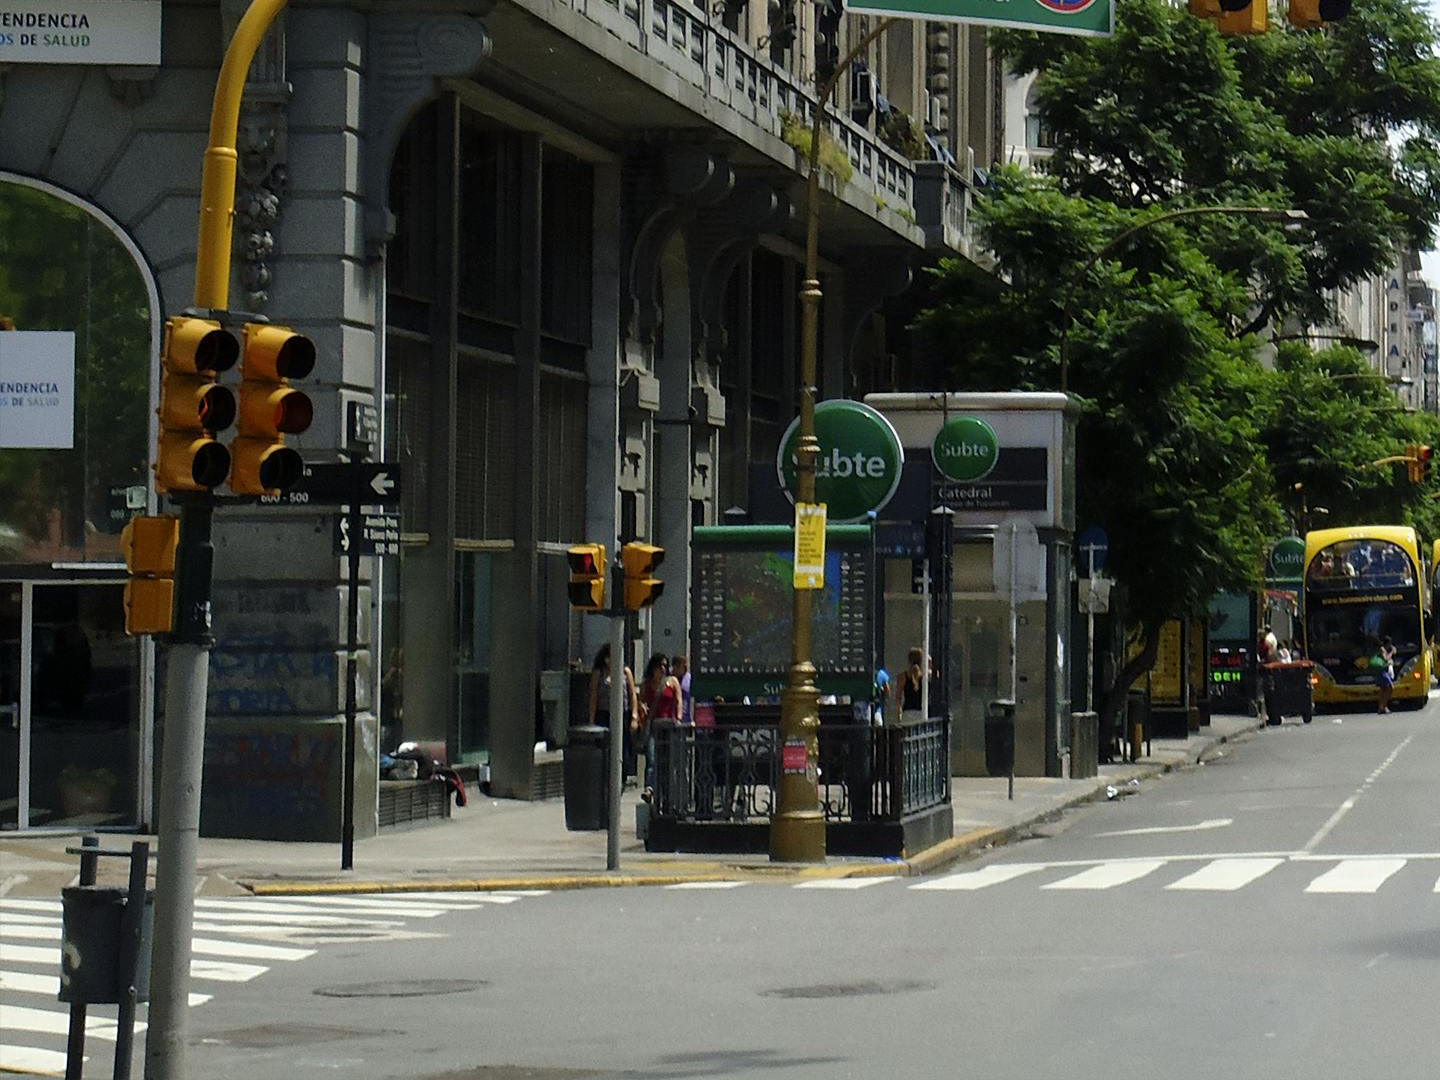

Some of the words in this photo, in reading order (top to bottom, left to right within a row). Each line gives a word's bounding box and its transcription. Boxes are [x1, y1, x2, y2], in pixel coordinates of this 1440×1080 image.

[0, 12, 90, 29] ENDENCIA
[20, 33, 37, 46] DE
[43, 34, 90, 47] SALUD
[12, 397, 22, 406] DE
[28, 397, 59, 406] SALUD
[940, 441, 989, 457] Subte
[289, 492, 309, 503] 500
[938, 486, 992, 499] Catedral
